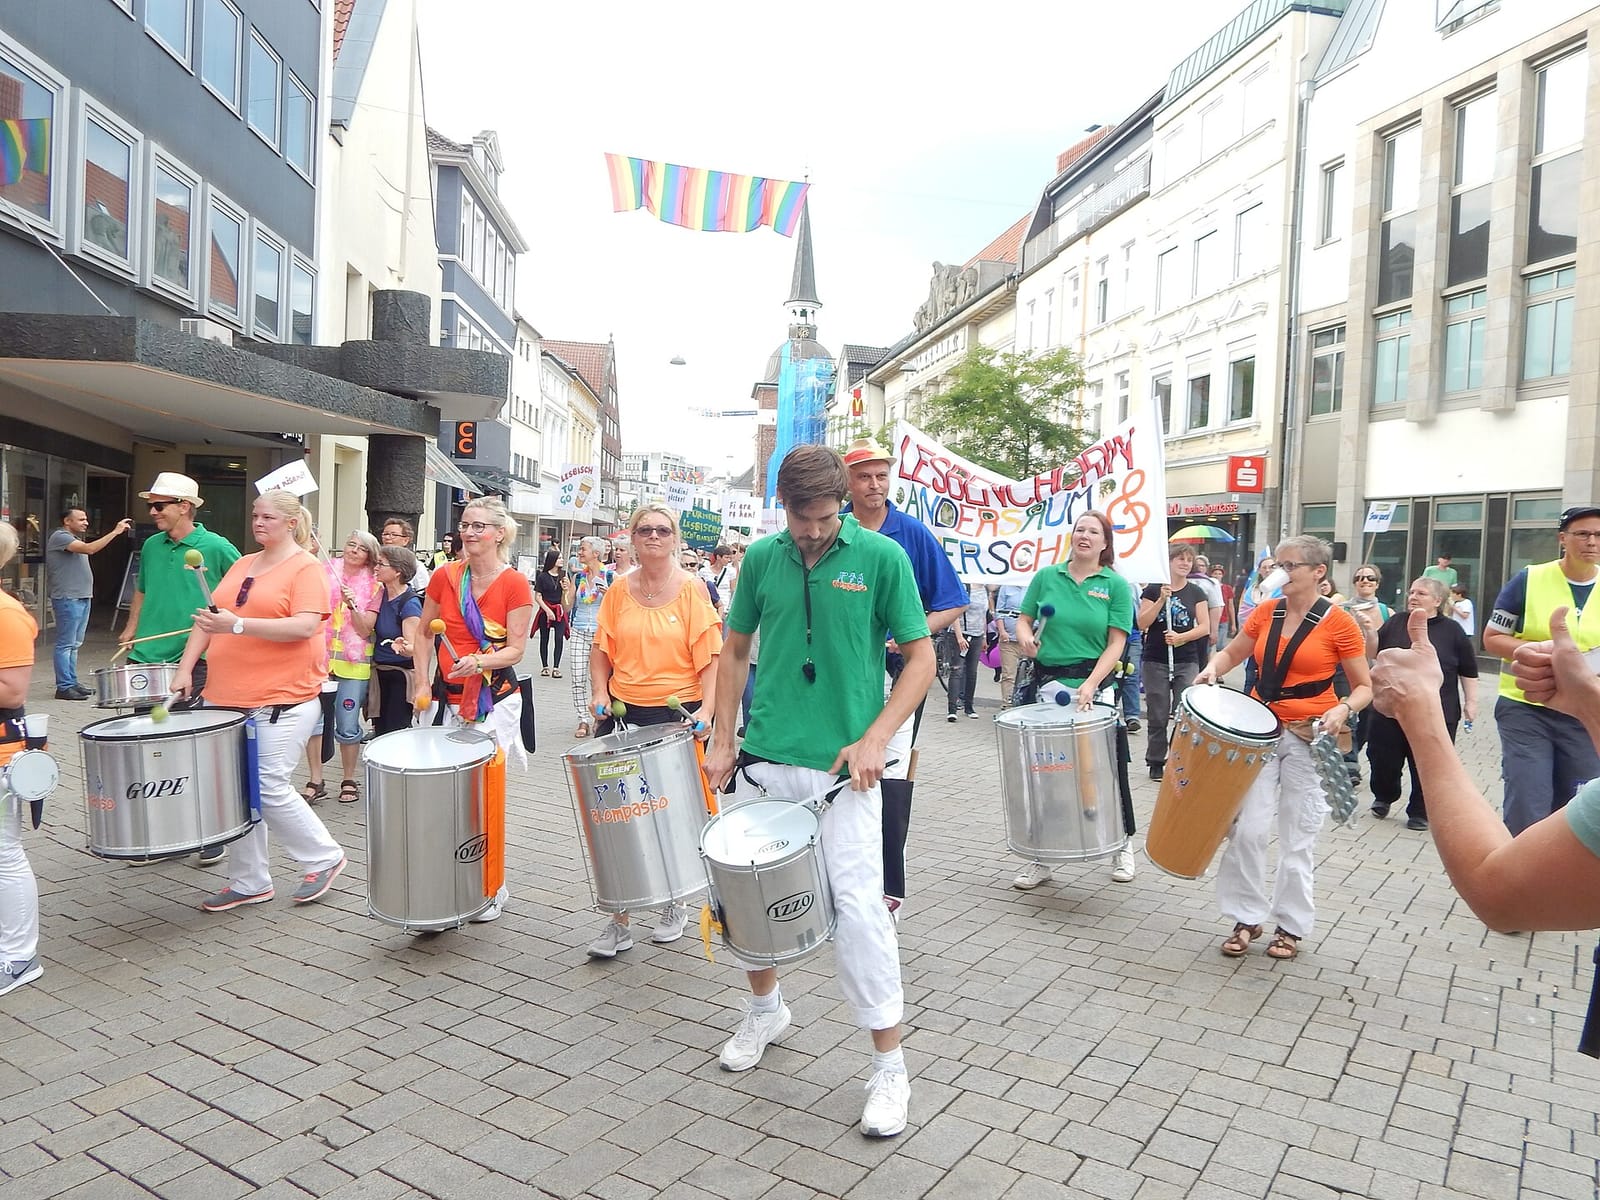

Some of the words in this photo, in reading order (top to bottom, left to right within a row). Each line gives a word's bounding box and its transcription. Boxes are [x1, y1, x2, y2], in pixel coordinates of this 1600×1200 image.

[560, 465, 594, 482] LESBISCH
[561, 483, 574, 494] TO
[560, 494, 572, 506] GO
[940, 533, 1072, 575] ERSCHI
[126, 776, 189, 800] GOPE
[772, 894, 810, 918] IZZO
